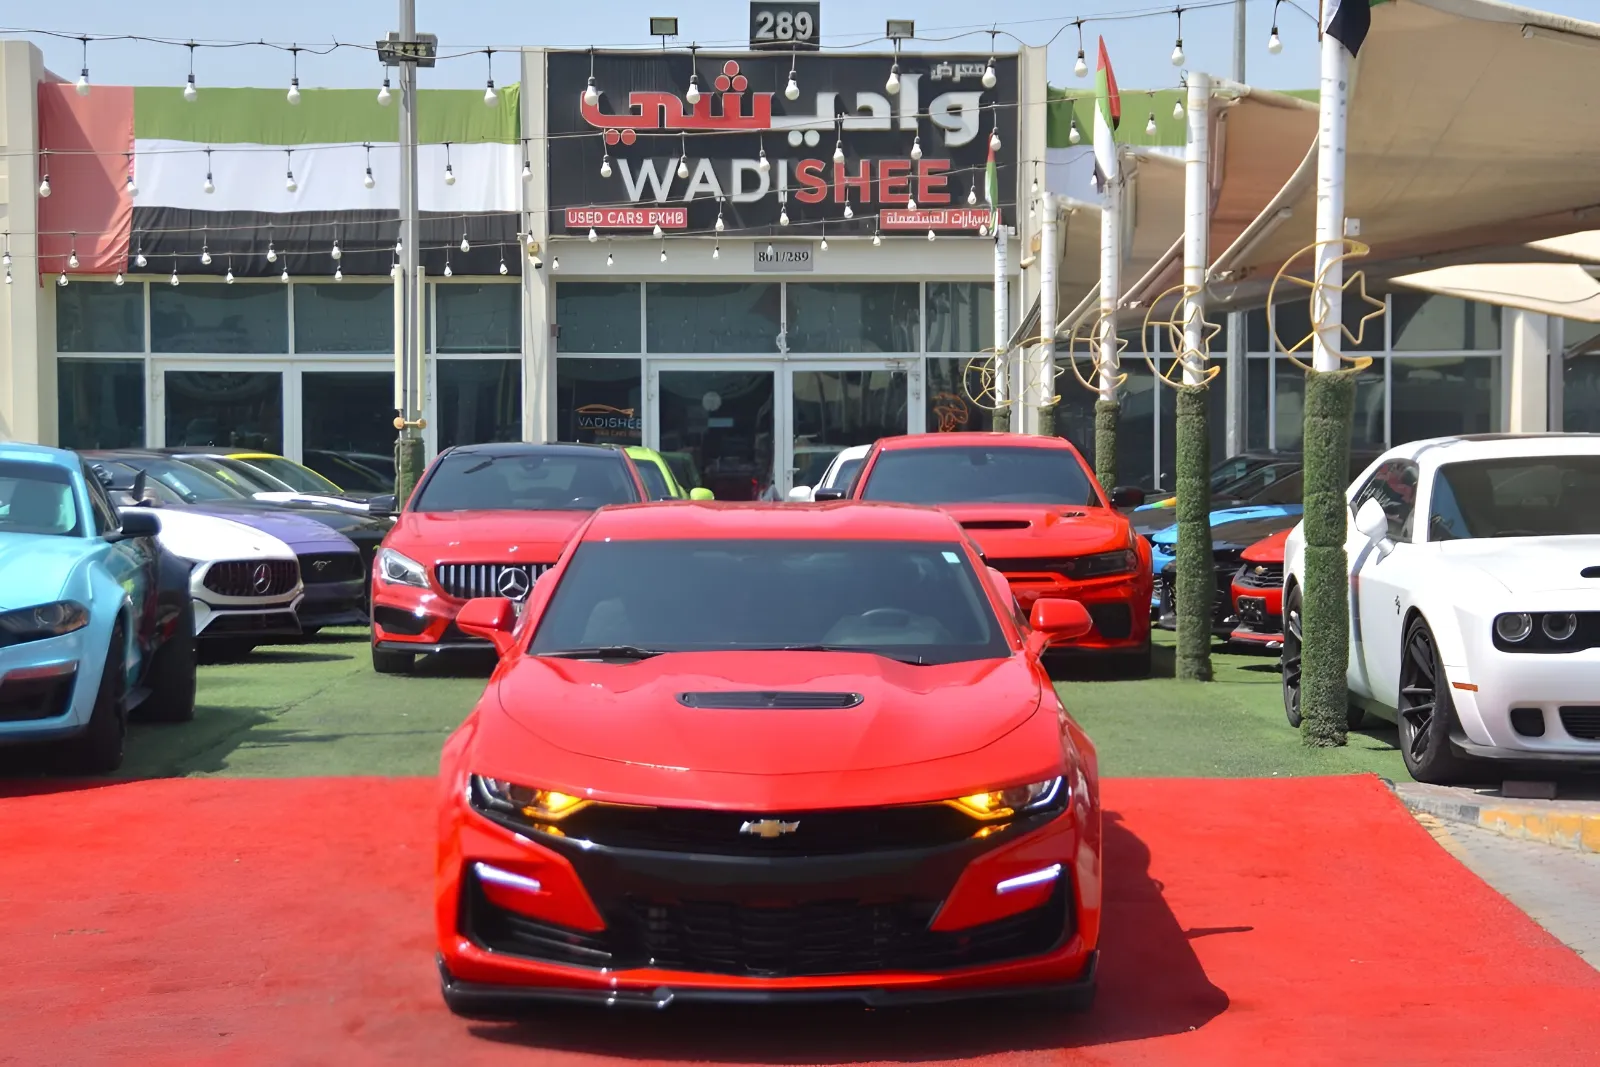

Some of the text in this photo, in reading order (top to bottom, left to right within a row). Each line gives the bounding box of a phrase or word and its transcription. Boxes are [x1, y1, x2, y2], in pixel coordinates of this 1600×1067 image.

[755, 11, 813, 40] 289
[616, 158, 951, 204] WADISHEE
[568, 211, 603, 224] USED
[607, 211, 644, 224] CARS
[886, 210, 994, 228] لسيارات المستعملة
